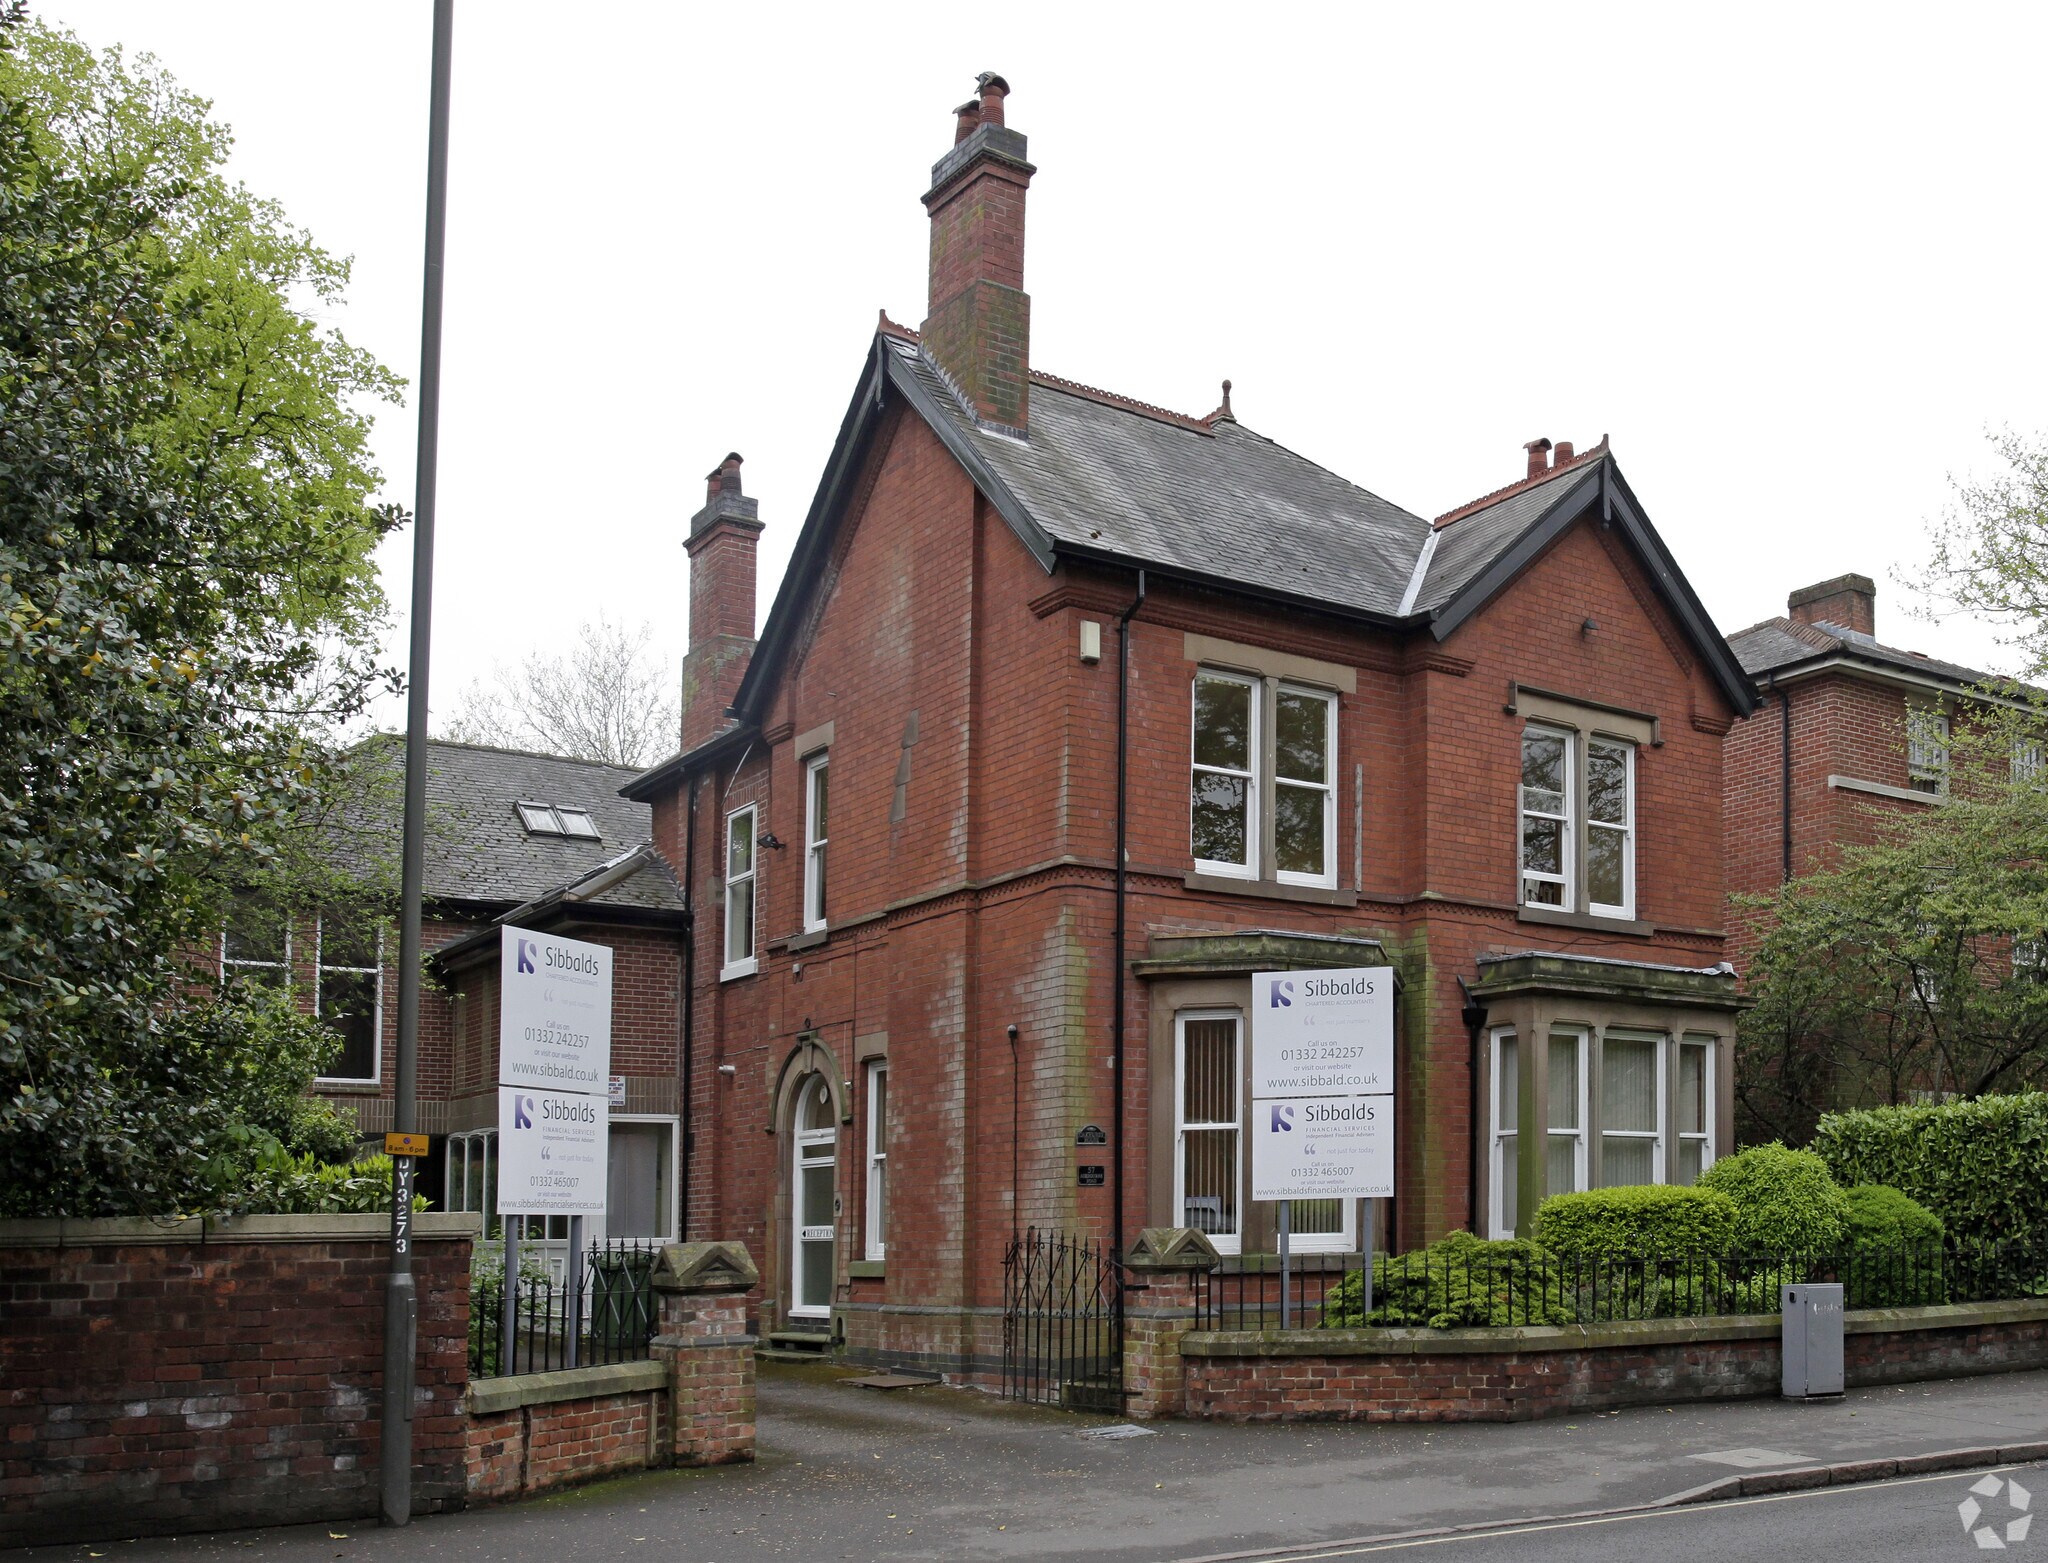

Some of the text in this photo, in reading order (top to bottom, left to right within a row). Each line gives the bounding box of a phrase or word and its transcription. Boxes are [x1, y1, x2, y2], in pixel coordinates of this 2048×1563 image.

[545, 946, 599, 976] Sibbalds
[1305, 977, 1374, 997] Sibbalds
[546, 1020, 556, 1029] Call
[524, 1027, 590, 1049] 01332 242257
[1281, 1046, 1364, 1061] 01332 242257
[512, 1062, 599, 1082] www.sibbald.co.uk
[1267, 1072, 1379, 1088] www.sibbald.co.uk
[542, 1099, 596, 1124] Sibbalds
[1305, 1103, 1375, 1122] Sibbalds
[543, 1126, 596, 1136] FINANCIAL SERVICES
[1291, 1166, 1354, 1177] 01332 465007
[530, 1176, 580, 1188] 01332 465007
[1256, 1184, 1391, 1196] www.sibbaldsfinancialservices.co.uk
[396, 1157, 410, 1254] DY3273
[500, 1199, 605, 1210] www.sibbaldsfinancialservices.co.uk
